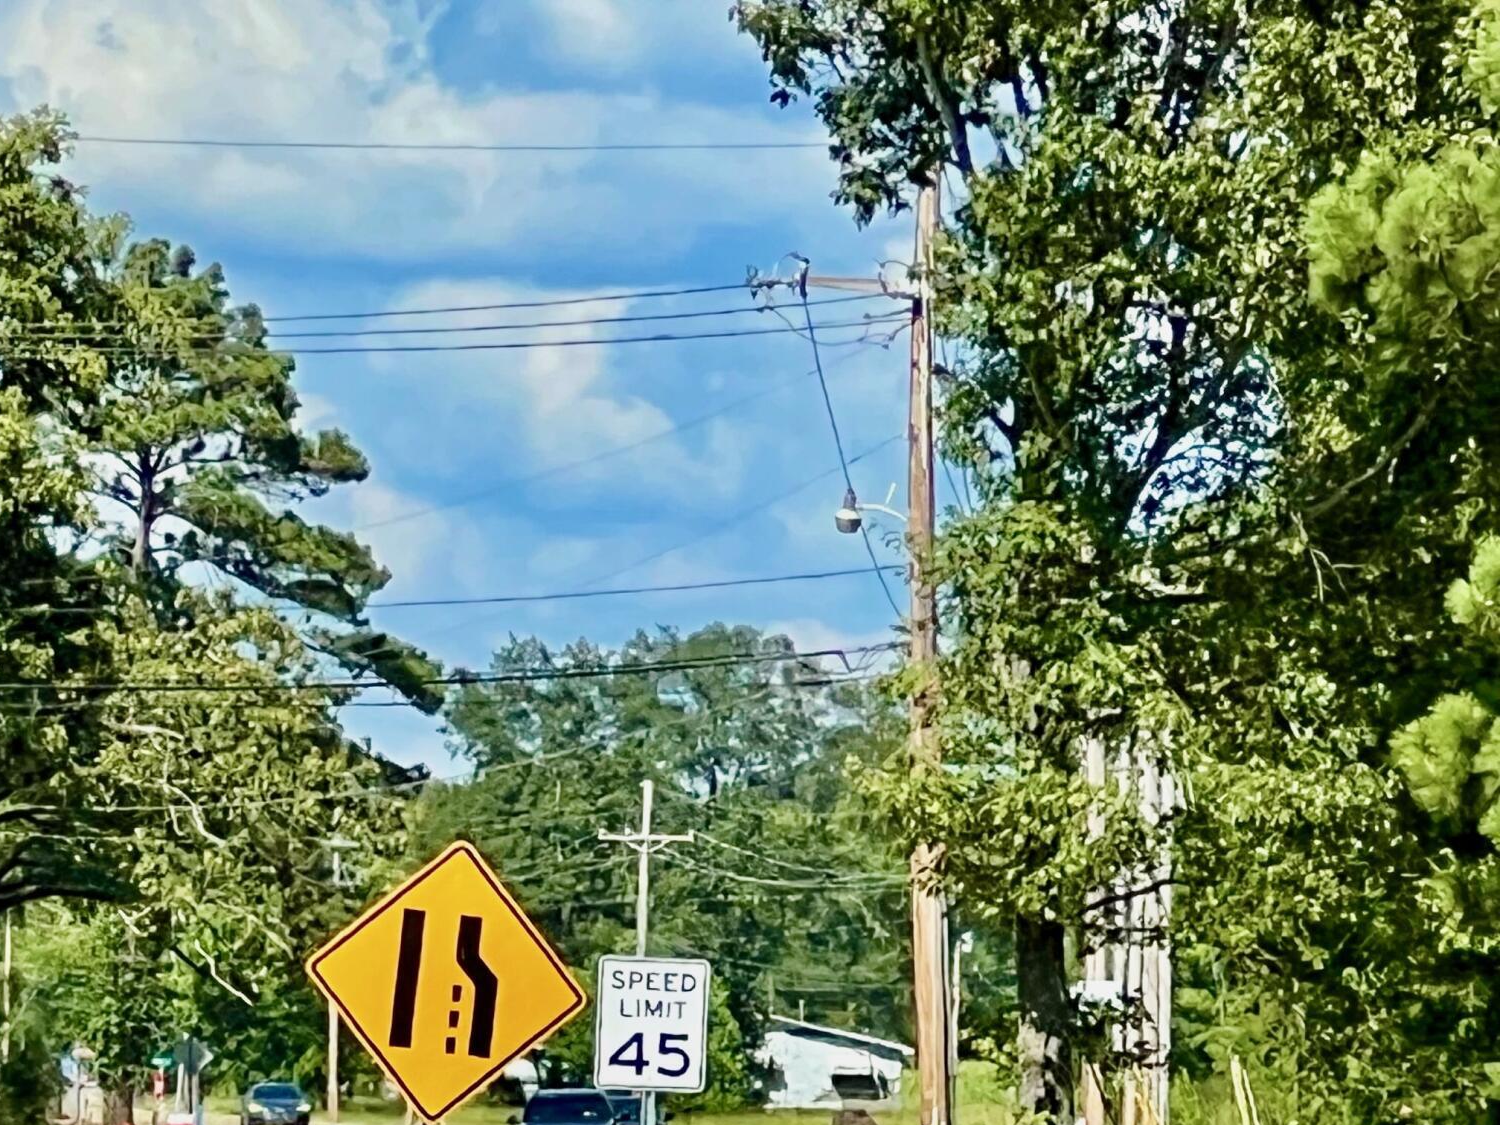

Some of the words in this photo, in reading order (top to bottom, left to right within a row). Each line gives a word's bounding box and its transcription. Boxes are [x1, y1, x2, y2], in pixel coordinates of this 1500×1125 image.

[611, 970, 696, 993] SPEED
[619, 998, 687, 1020] LIMIT
[608, 1032, 691, 1078] 45
